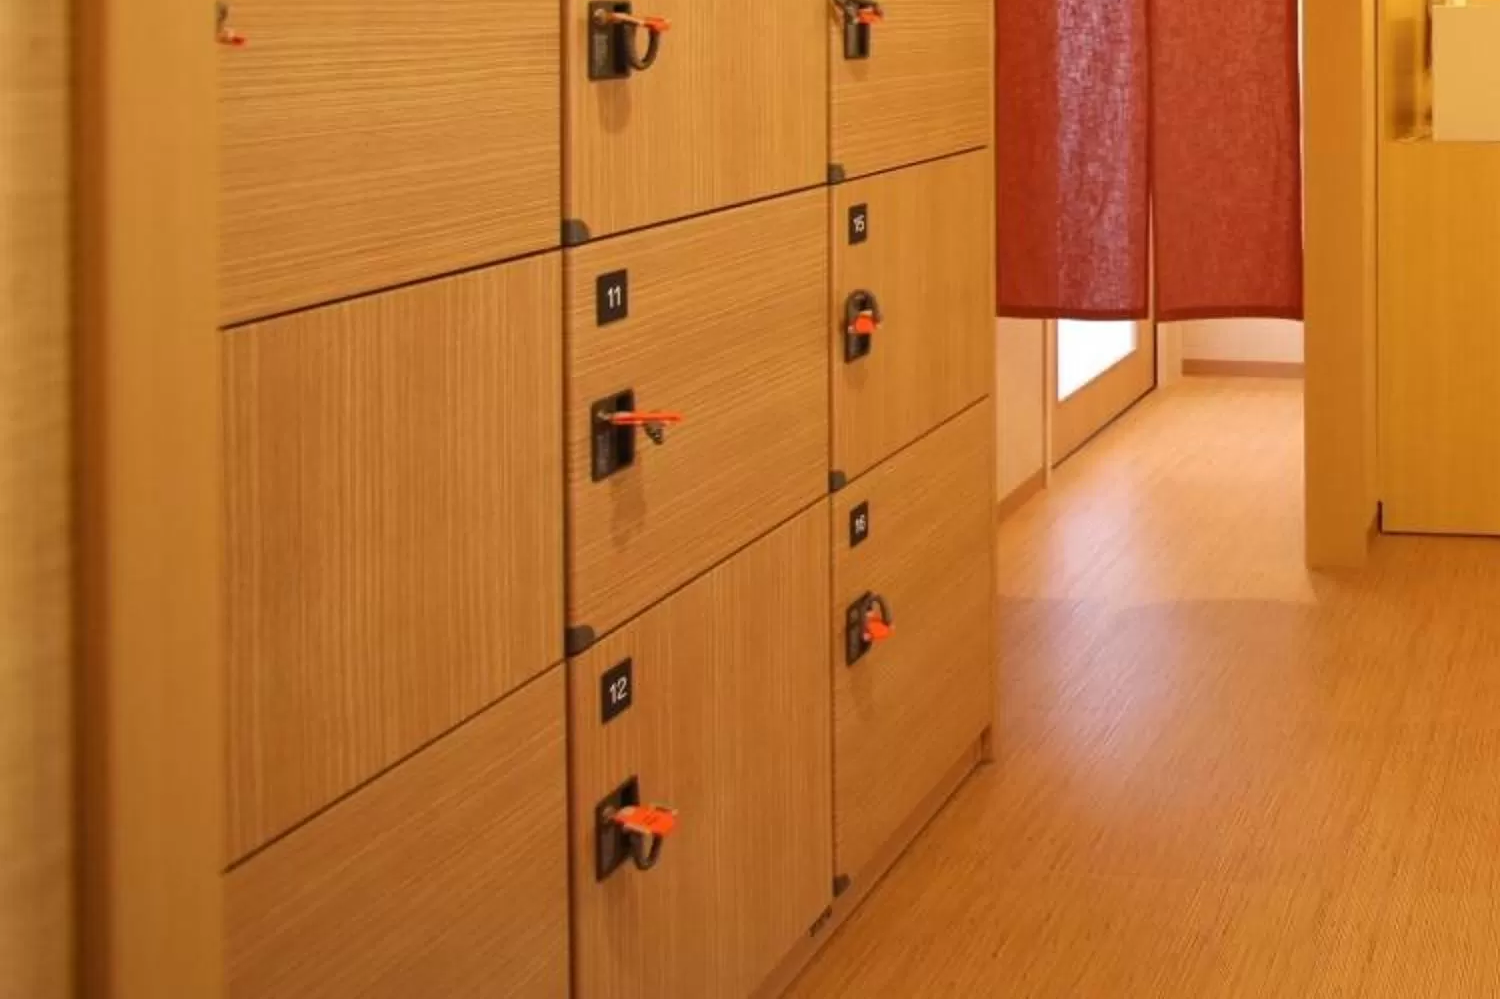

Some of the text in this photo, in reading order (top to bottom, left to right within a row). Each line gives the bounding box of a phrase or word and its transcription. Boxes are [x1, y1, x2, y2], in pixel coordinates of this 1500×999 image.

[853, 214, 865, 233] 15
[607, 285, 622, 308] 11
[609, 676, 628, 704] 12
